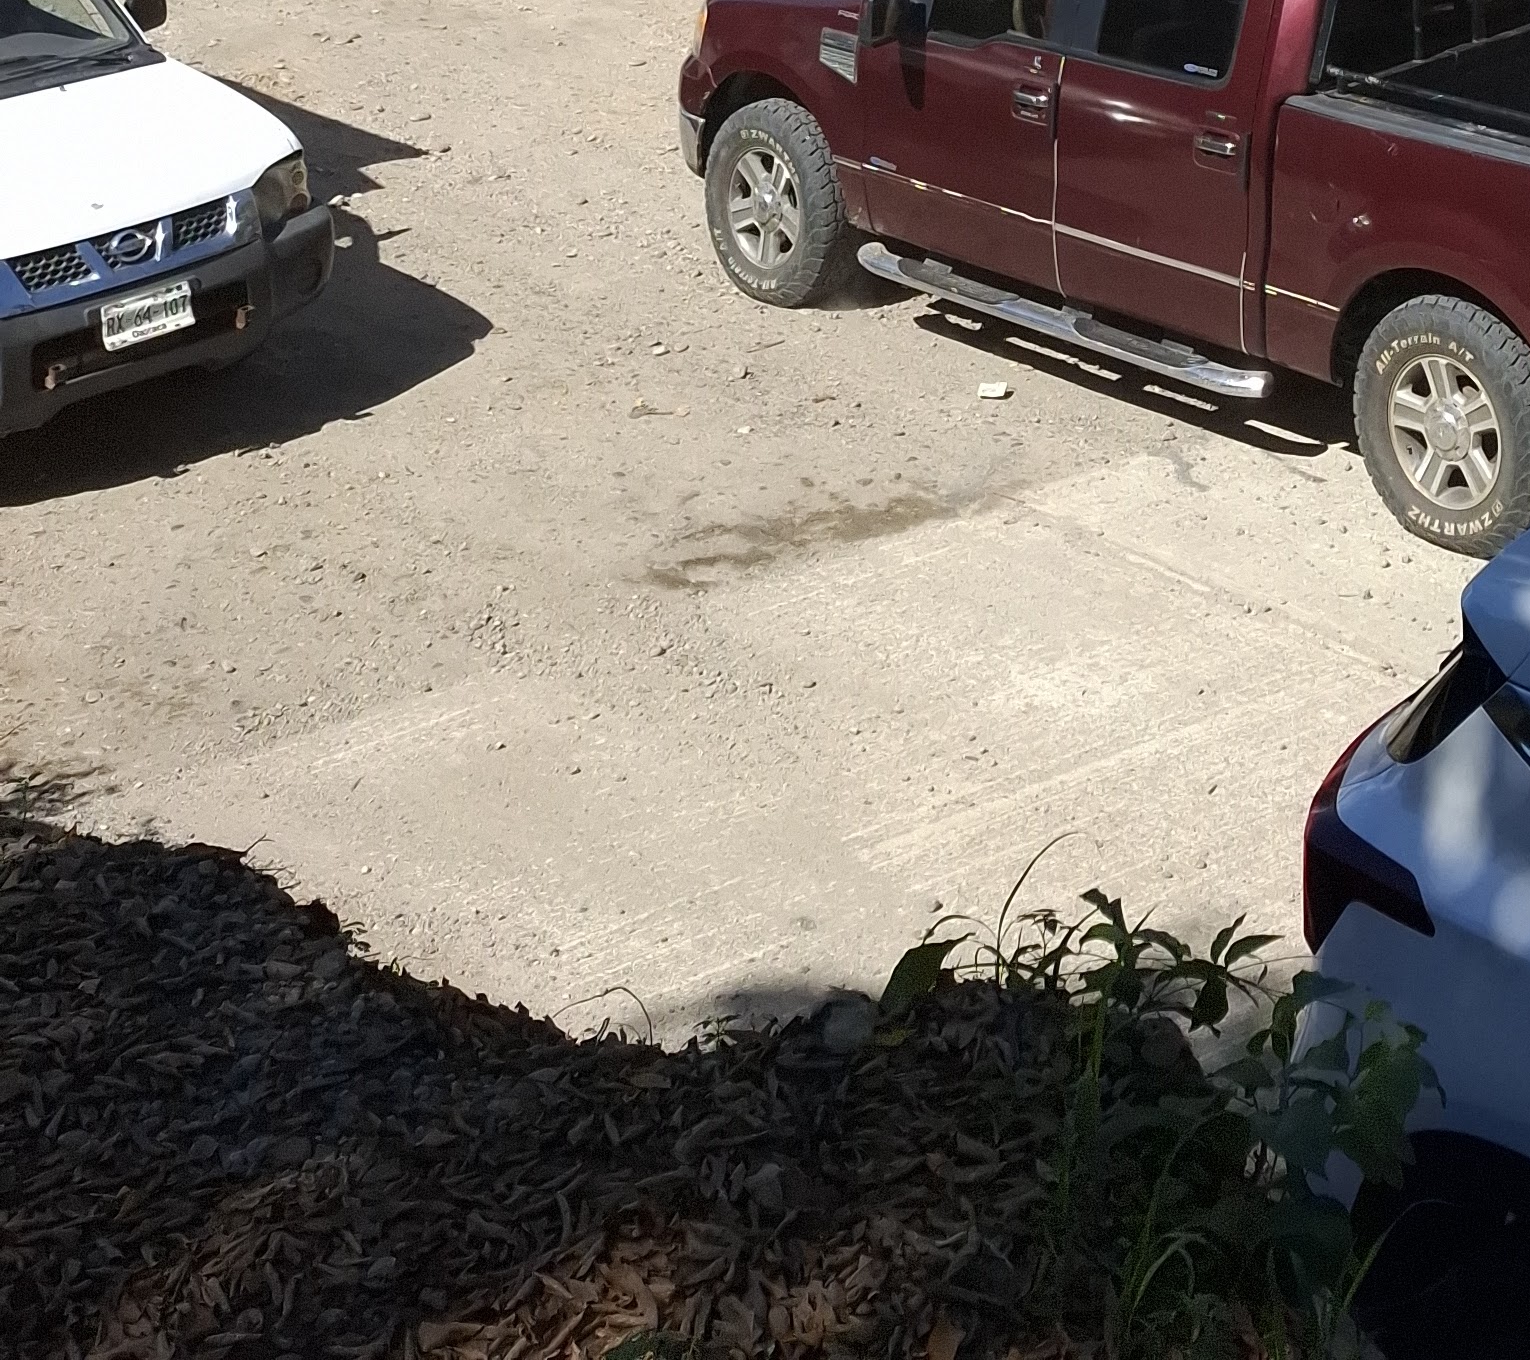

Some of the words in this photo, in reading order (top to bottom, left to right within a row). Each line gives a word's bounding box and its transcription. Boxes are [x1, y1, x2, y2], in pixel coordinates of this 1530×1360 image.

[1375, 332, 1441, 376] All-Terrain
[1448, 341, 1475, 362] A/T
[1407, 505, 1493, 536] ZWARTHZ
